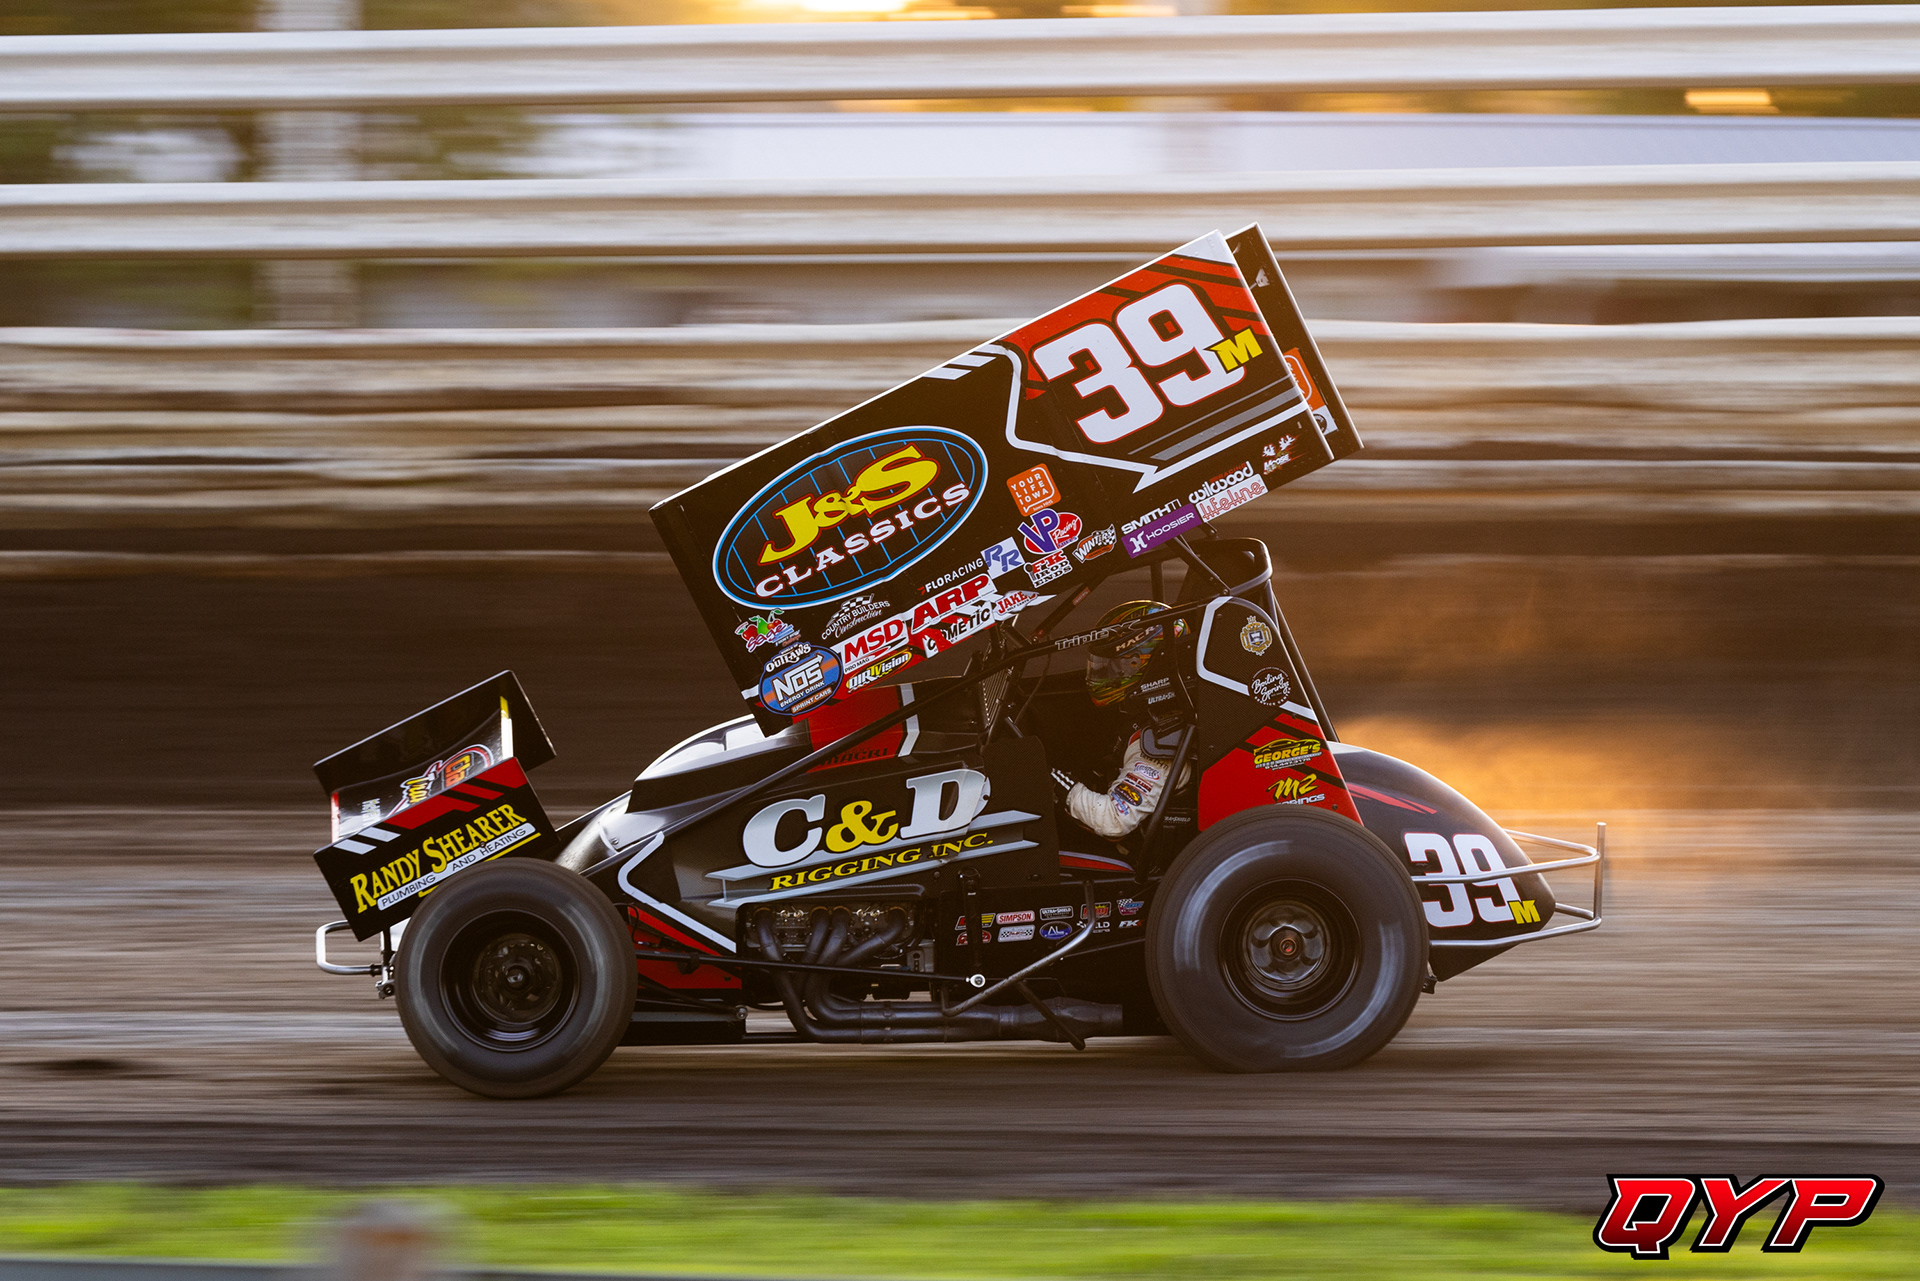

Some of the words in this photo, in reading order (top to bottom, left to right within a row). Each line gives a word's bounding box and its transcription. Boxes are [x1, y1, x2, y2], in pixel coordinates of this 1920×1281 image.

[1033, 282, 1246, 444] 39
[1209, 328, 1263, 373] M
[1011, 473, 1042, 490] YOUR
[1015, 480, 1045, 498] LIFE
[1188, 461, 1254, 504] wilwood
[759, 443, 938, 564] J&S
[1019, 488, 1049, 505] IOWA
[755, 482, 971, 598] CLASSICS
[1018, 508, 1060, 554] VP
[1052, 517, 1079, 540] Racing
[1146, 512, 1195, 540] HOOSIER
[1032, 551, 1067, 574] FK
[1035, 566, 1073, 587] ENDS
[1039, 561, 1069, 579] ROD
[912, 575, 989, 630] ARP
[821, 613, 852, 640] COUNTRY
[851, 601, 891, 617] BUILDERS
[835, 610, 882, 638] Construction
[845, 619, 903, 664] MSD
[773, 655, 824, 702] NOS
[844, 664, 857, 673] PRO
[856, 658, 870, 668] MAG
[780, 692, 804, 708] ENERGY
[805, 681, 825, 695] DRINK
[1141, 678, 1170, 690] SHARP
[1251, 673, 1284, 695] Boiling
[1260, 681, 1290, 702] Springs
[791, 698, 815, 714] SPRINT
[814, 689, 832, 702] CARS
[1254, 743, 1321, 765] GEORGE'S
[742, 769, 991, 867] C&D
[350, 849, 421, 914] RANDY
[422, 803, 527, 874] SHEARER
[381, 874, 437, 908] PLUMBING
[451, 853, 477, 872] AND
[480, 827, 527, 857] HEATING
[769, 847, 921, 892] RIGGING
[929, 832, 994, 859] INC.
[1404, 832, 1522, 928] 39
[1507, 899, 1541, 925] M
[999, 912, 1032, 923] SIMPSON
